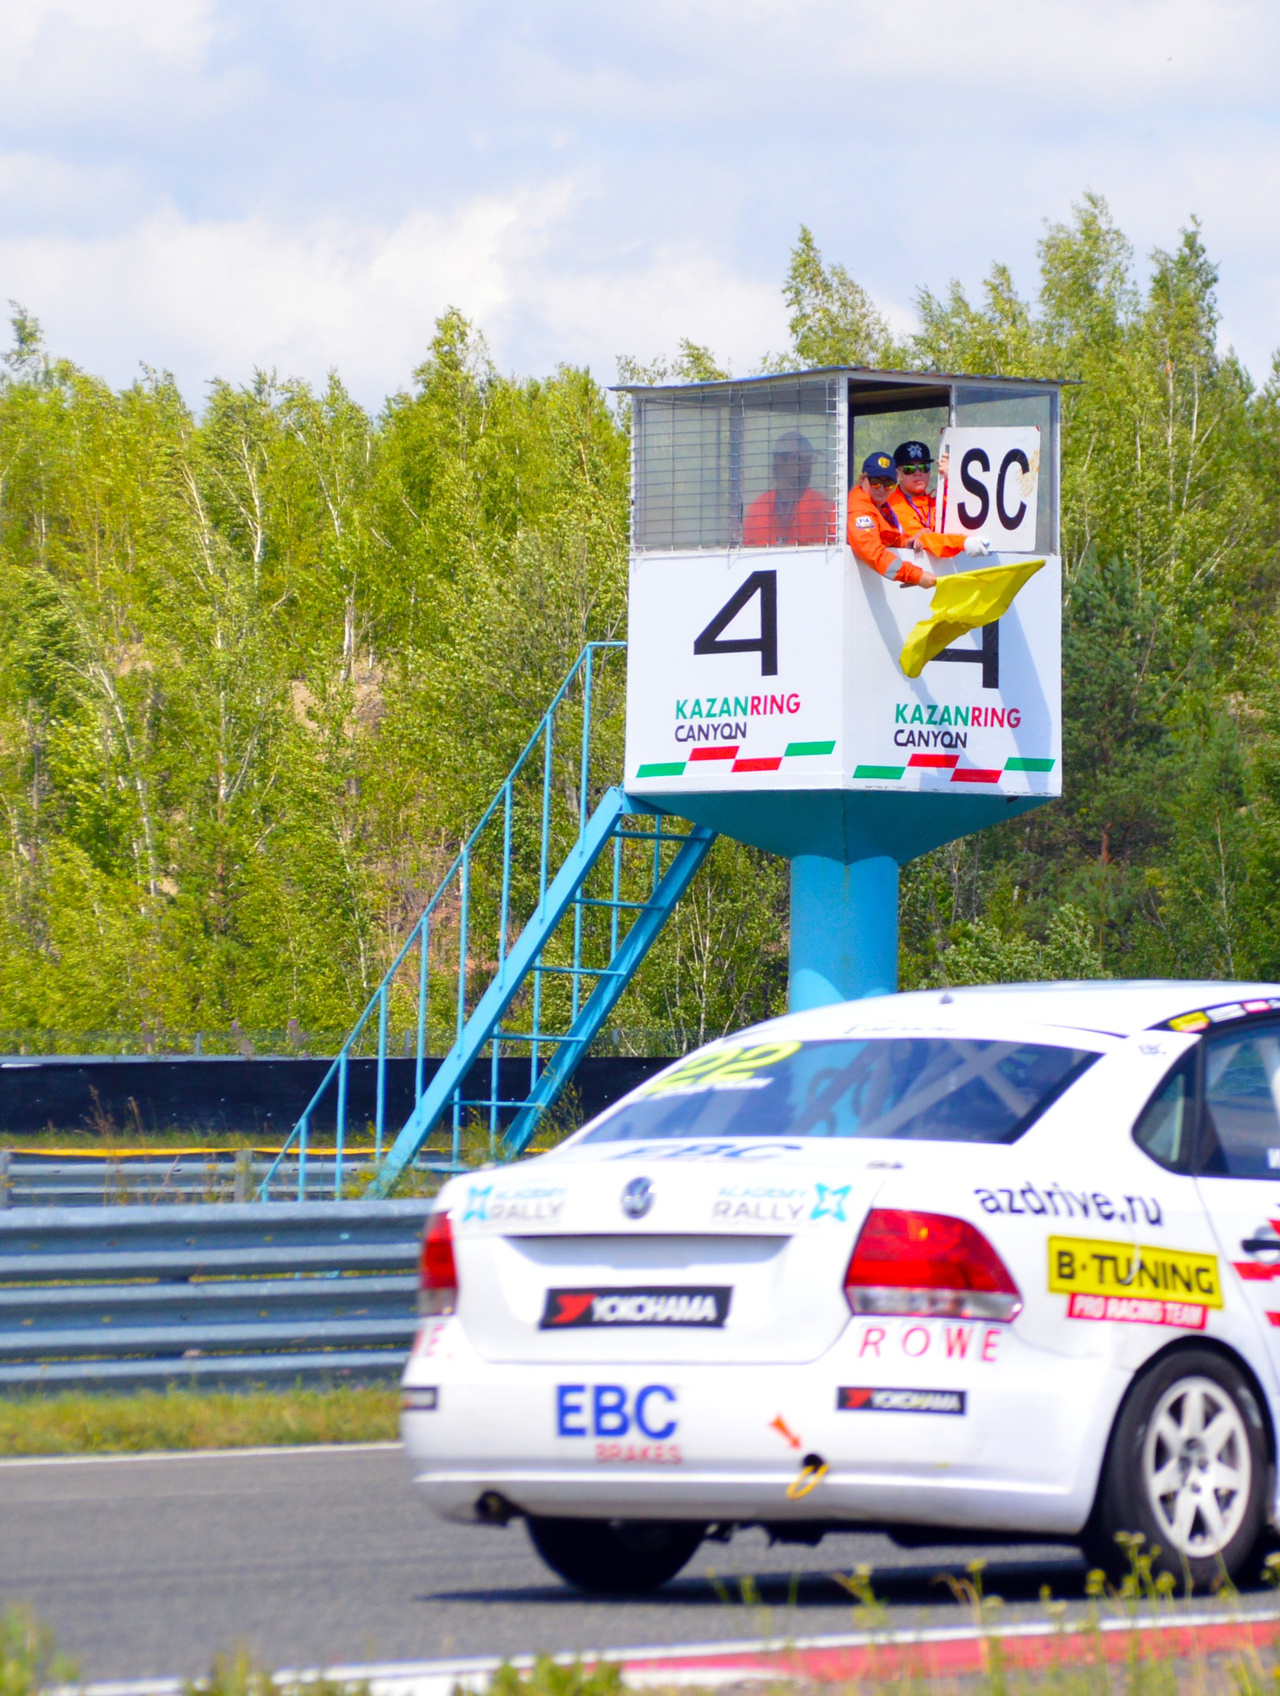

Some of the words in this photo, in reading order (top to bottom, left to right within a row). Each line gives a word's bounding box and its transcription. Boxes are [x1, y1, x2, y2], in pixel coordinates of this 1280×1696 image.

[957, 449, 1030, 530] SC
[694, 570, 778, 676] 4
[674, 722, 747, 742] CANYON
[893, 729, 968, 749] CANYON
[711, 1200, 806, 1221] RALLY
[973, 1181, 1163, 1227] azdrive.ru
[591, 1295, 718, 1322] YOKOHAMA
[857, 1326, 1002, 1362] ROWE
[556, 1384, 678, 1440] EBC
[871, 1390, 962, 1412] YOKOHAMA
[596, 1443, 683, 1465] BRAKES
